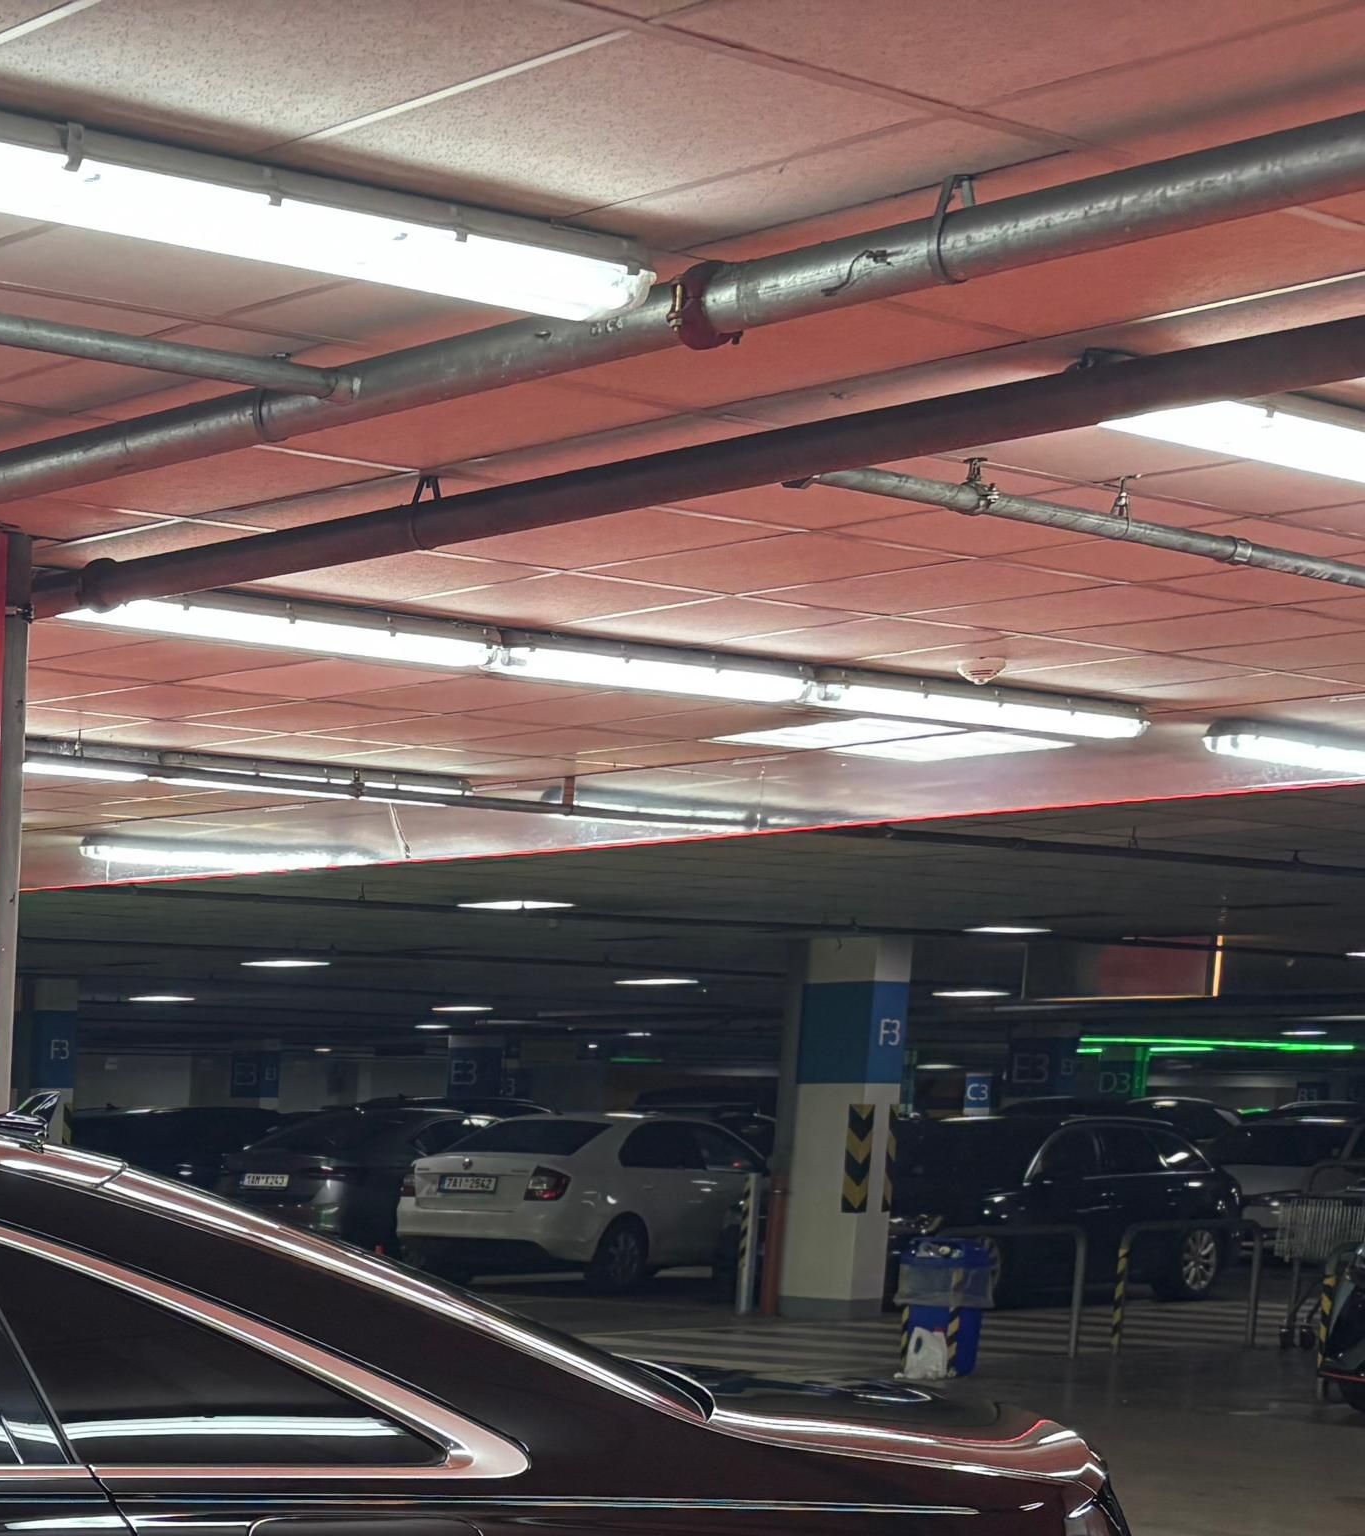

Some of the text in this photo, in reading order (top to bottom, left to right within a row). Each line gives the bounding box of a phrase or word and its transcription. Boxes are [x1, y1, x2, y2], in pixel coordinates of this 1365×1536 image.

[879, 1018, 901, 1047] F3
[50, 1039, 70, 1060] F3
[966, 1083, 989, 1101] C3
